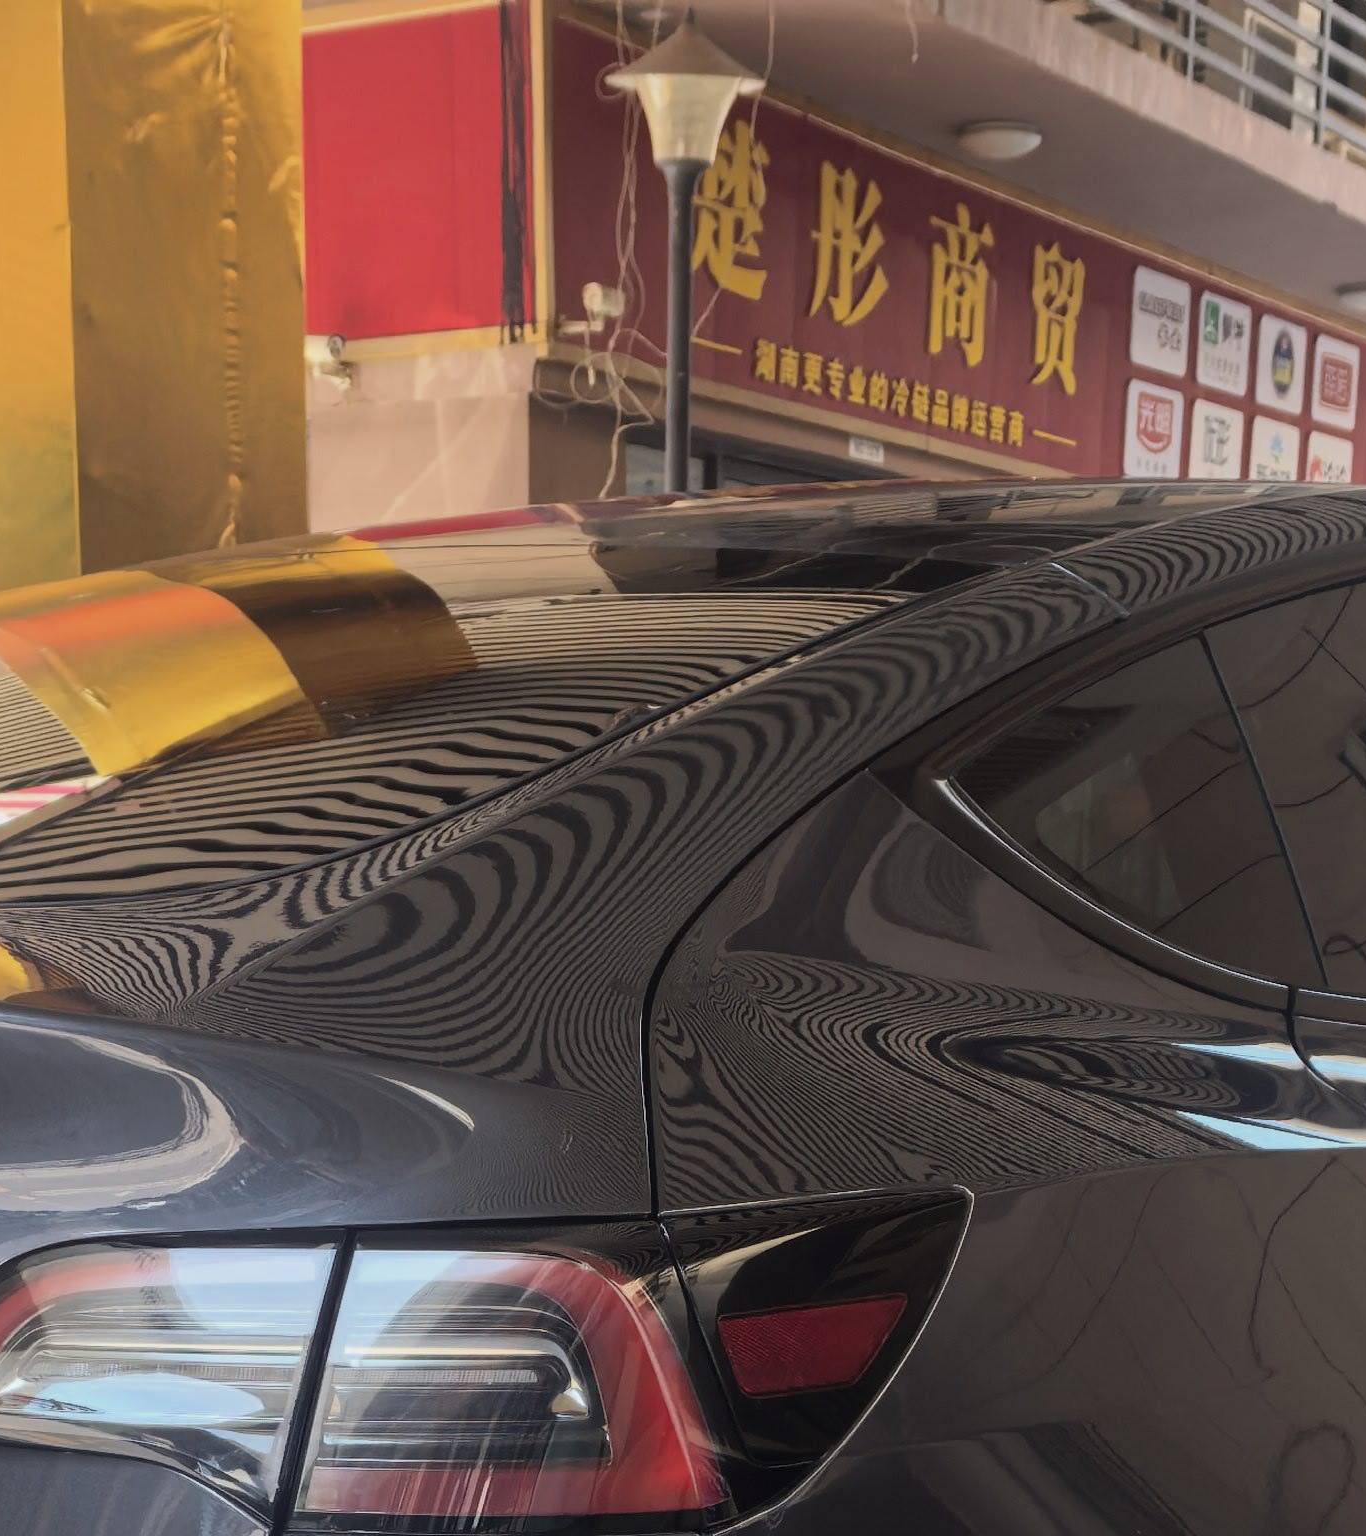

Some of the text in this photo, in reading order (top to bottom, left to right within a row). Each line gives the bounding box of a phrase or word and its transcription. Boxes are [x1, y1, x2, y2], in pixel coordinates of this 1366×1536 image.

[754, 337, 1025, 447] 湖南更专业的冷链品牌运营商
